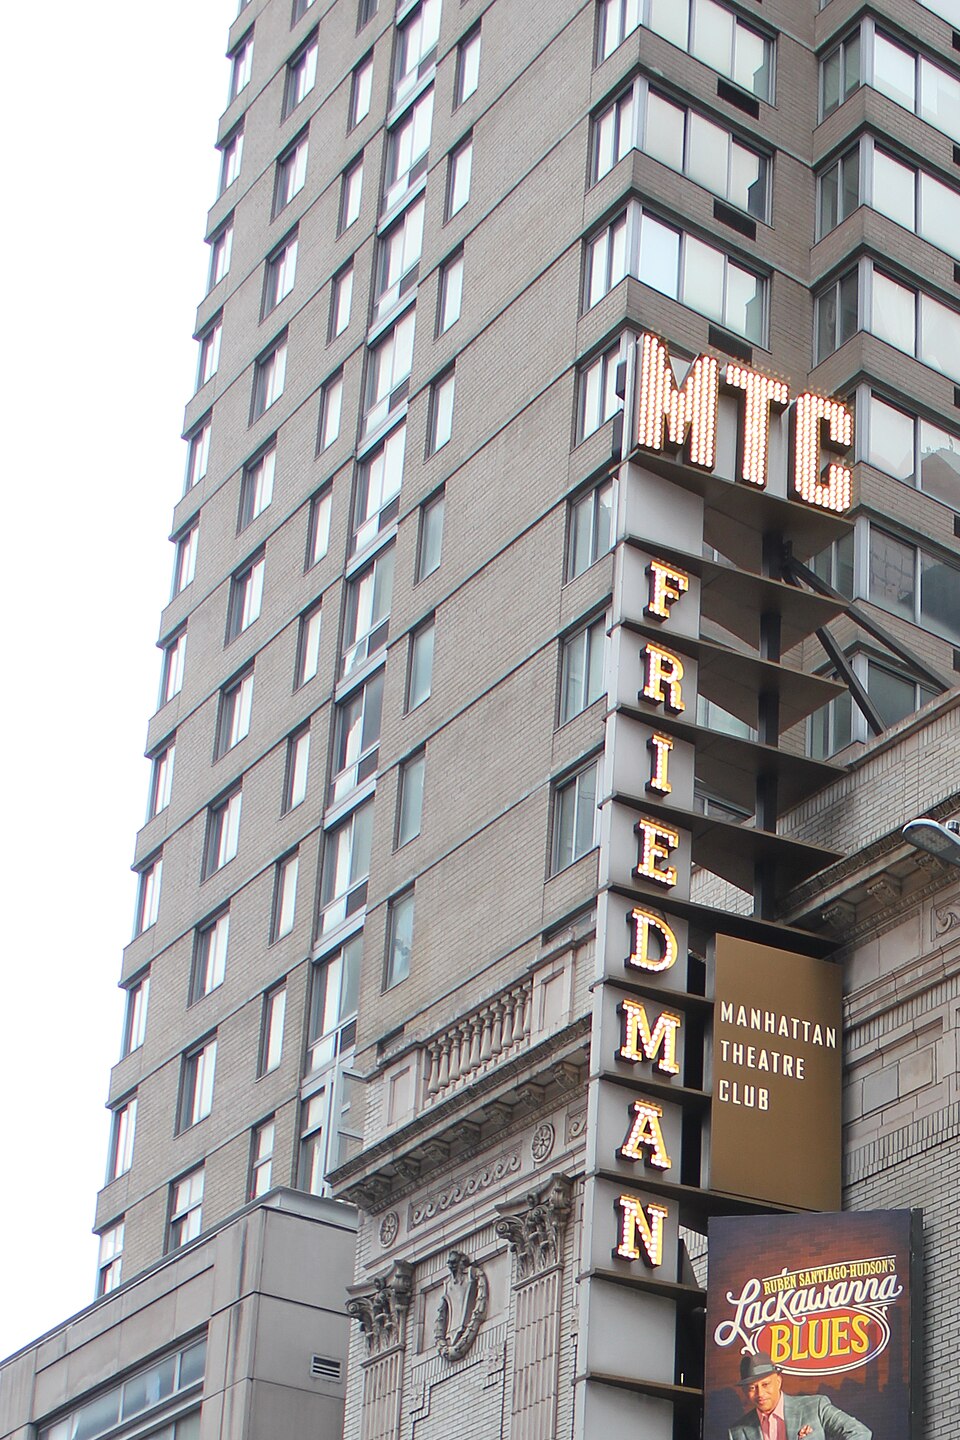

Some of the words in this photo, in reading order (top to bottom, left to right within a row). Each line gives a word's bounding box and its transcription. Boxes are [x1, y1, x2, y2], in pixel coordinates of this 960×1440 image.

[637, 333, 853, 513] MTC
[613, 560, 690, 1268] FRIEDMAN
[720, 1001, 837, 1049] MANHATTAN
[720, 1040, 806, 1080] THEATRE
[719, 1079, 769, 1111] CLUB
[764, 1276, 797, 1296] RUBEN
[799, 1258, 896, 1287] SANTIAGO-HUDSON'S
[769, 1314, 872, 1363] BLUES
